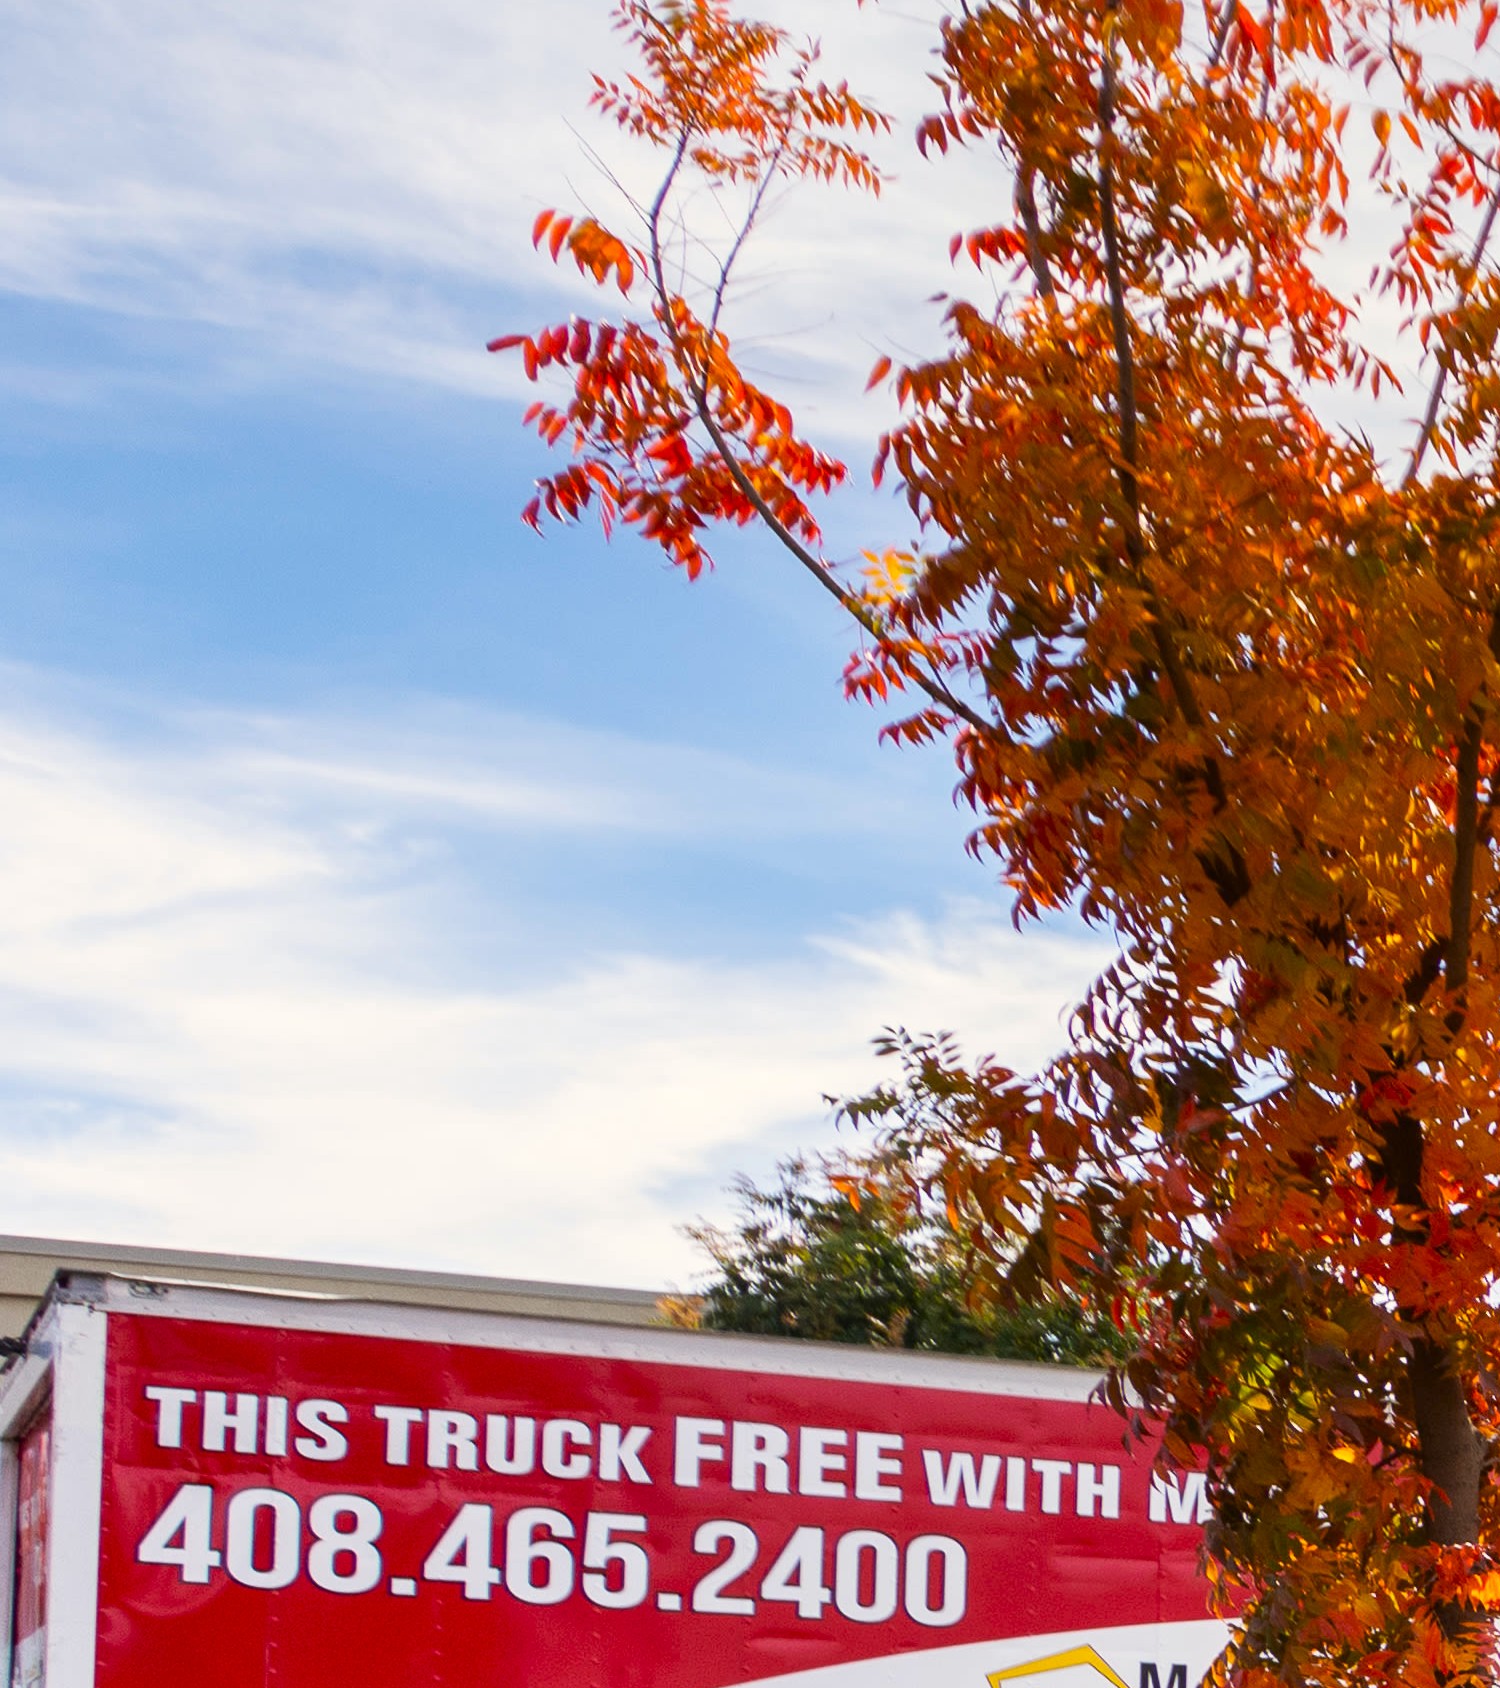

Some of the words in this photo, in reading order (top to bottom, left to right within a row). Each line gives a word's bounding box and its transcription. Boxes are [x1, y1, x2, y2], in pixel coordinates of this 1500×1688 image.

[145, 1385, 349, 1462] THIS
[374, 1404, 653, 1485] TRUCK
[673, 1415, 904, 1503] FREE
[921, 1448, 1121, 1520] WITH
[137, 1483, 968, 1627] 408.465.2400
